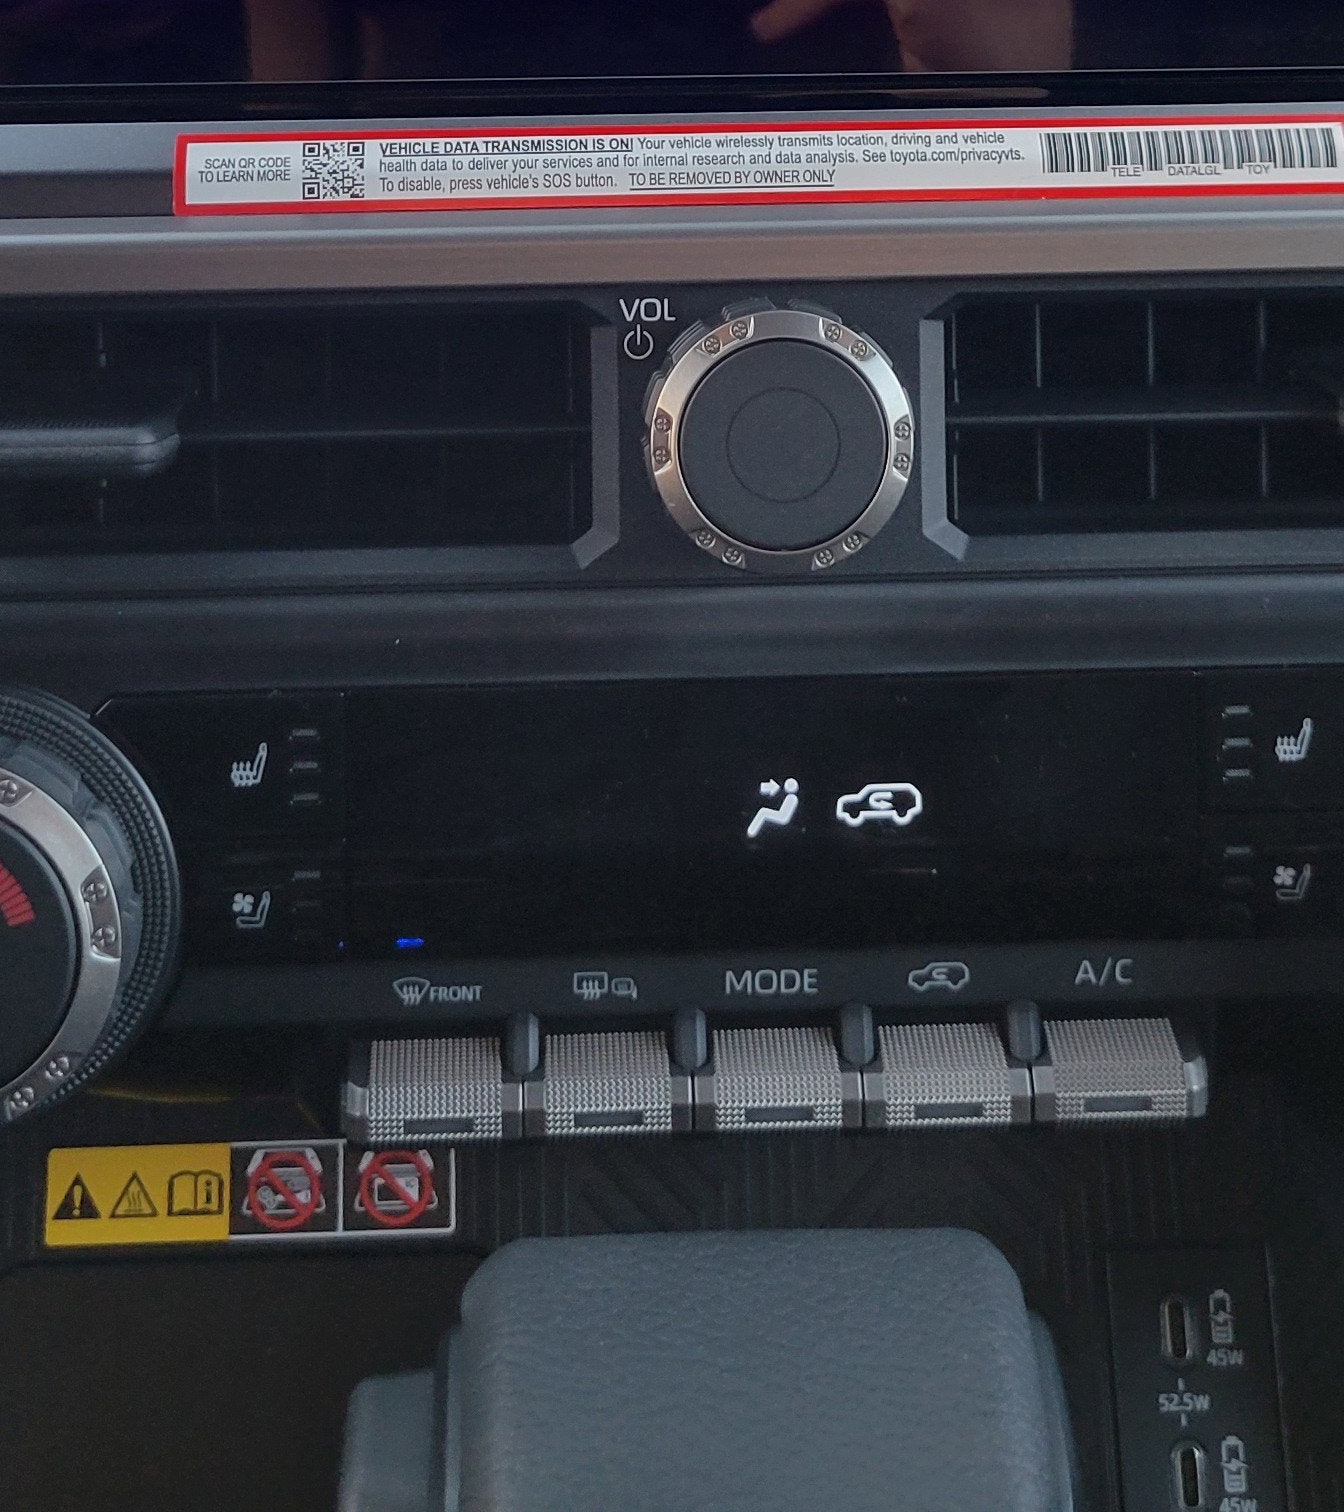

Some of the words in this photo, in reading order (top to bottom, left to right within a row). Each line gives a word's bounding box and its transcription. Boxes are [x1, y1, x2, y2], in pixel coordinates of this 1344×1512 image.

[380, 142, 440, 155] VEHICLE
[444, 141, 479, 153] DATA
[483, 139, 588, 152] TRANSMISSION
[592, 139, 605, 151] IS
[638, 138, 666, 149] Your
[669, 136, 711, 149] vehicle
[715, 135, 774, 150] wirelessly
[778, 134, 833, 147] transmits
[837, 133, 887, 147] location,
[891, 133, 931, 147] driving
[936, 132, 958, 144] and
[962, 131, 1005, 144] vehicle
[205, 158, 237, 169] SCAN
[238, 158, 256, 169] QR
[258, 157, 291, 168] CODE
[379, 159, 417, 172] health
[421, 158, 447, 171] data
[452, 158, 464, 171] to
[468, 157, 508, 170] deliver
[511, 158, 539, 173] your
[542, 155, 593, 169] services
[596, 154, 619, 168] and
[623, 153, 639, 167] for
[643, 153, 688, 166] internal
[692, 152, 745, 165] research
[749, 151, 772, 164] and
[775, 150, 802, 164] data
[805, 150, 858, 166] analysis.
[862, 149, 887, 162] See
[890, 147, 1025, 165] toyota.com/privacyvts.
[1111, 167, 1142, 178] TELE
[1167, 165, 1221, 176] DATALGL
[1247, 164, 1270, 175] TOY
[198, 171, 214, 182] TO
[217, 170, 255, 182] LEARN
[257, 169, 291, 181] MORE
[379, 178, 394, 192] To
[398, 177, 445, 192] disable,
[449, 177, 483, 193] press
[486, 174, 539, 189] vehicle's
[542, 173, 571, 188] SOS
[575, 173, 617, 188] button.
[629, 172, 646, 186] TO
[649, 172, 666, 185] BE
[669, 171, 732, 185] REMOVED
[734, 170, 751, 184] BY
[753, 170, 800, 183] OWNER
[803, 169, 836, 183] ONLY
[619, 298, 676, 322] VOL
[724, 966, 819, 998] MODE
[1074, 958, 1134, 987] A/C
[429, 982, 483, 1004] FRONT
[1207, 1349, 1244, 1366] 45W
[1219, 1497, 1257, 1512] 45W
